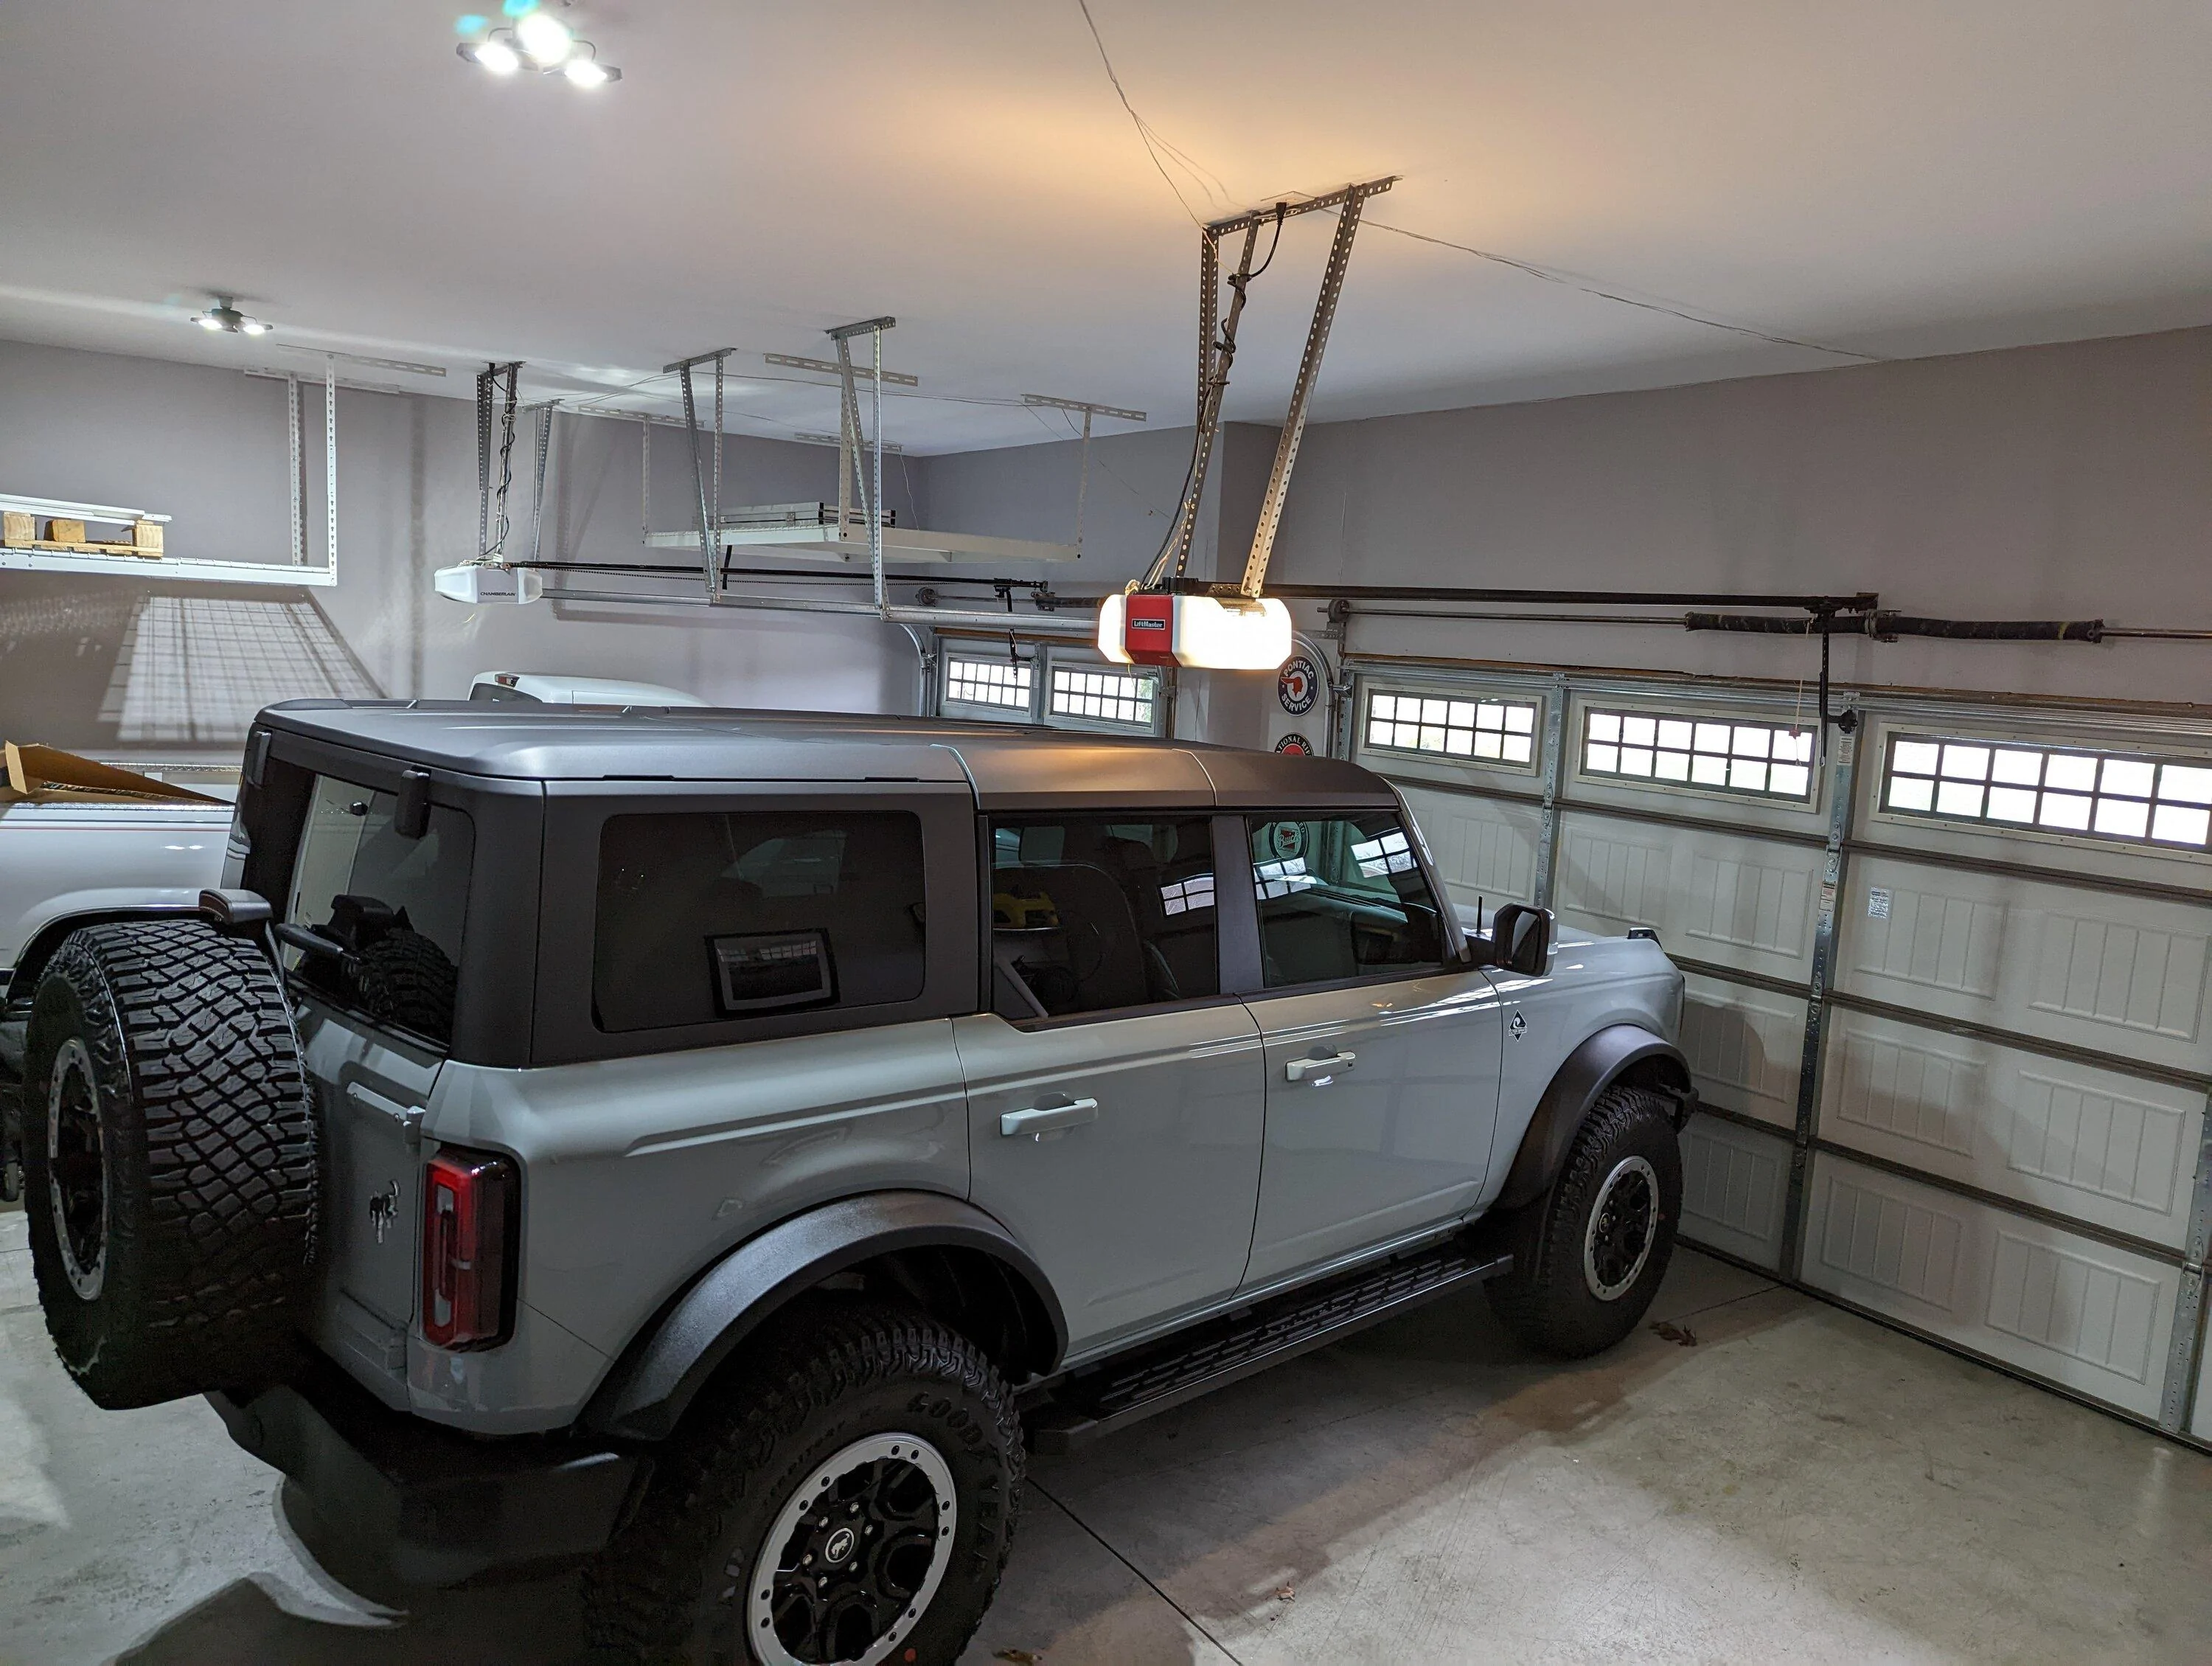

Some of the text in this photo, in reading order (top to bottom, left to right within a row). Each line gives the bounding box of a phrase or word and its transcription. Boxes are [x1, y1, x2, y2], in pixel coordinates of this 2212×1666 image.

[1283, 660, 1314, 679] PONTIAC
[1281, 693, 1312, 712] SERVICE
[1276, 735, 1301, 753] TIONAL
